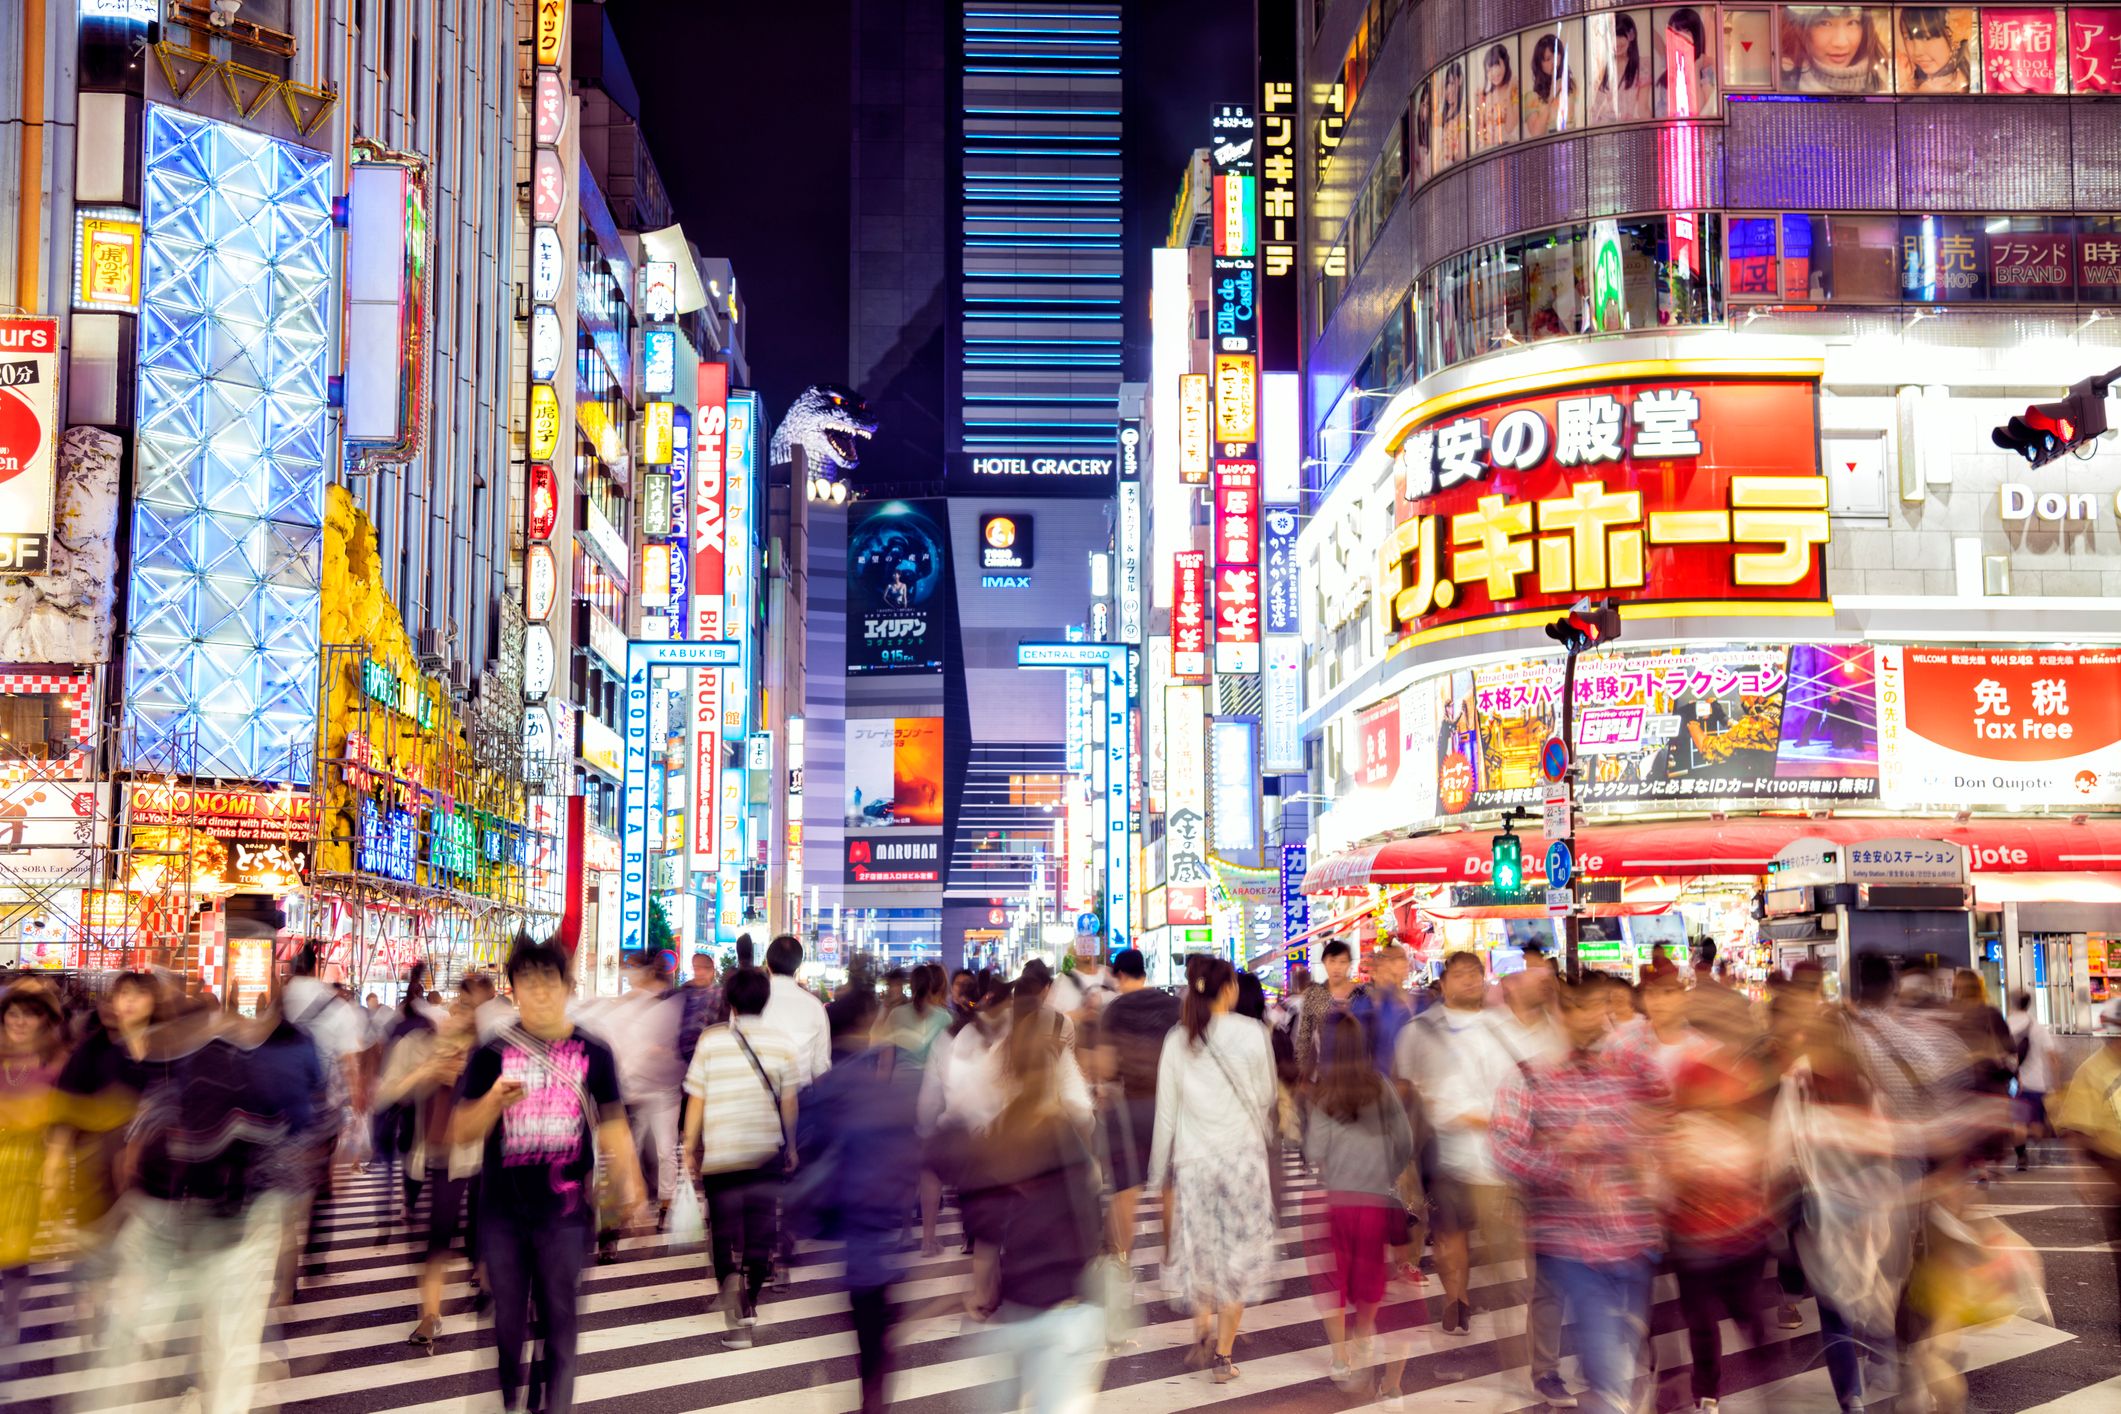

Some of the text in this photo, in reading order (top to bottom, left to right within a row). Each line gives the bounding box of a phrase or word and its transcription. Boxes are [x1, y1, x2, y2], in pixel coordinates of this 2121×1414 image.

[1989, 21, 2052, 52] 新宿
[2016, 59, 2049, 69] IDOL
[2016, 68, 2054, 79] STAGE
[88, 221, 110, 231] 4F
[1993, 242, 2067, 265] ブランド
[99, 247, 122, 285] 虎の子
[1995, 266, 2067, 284] BRAND
[1235, 270, 1253, 321] Castle
[1218, 278, 1235, 335] Elle de
[536, 406, 555, 442] 虎の子
[1224, 442, 1248, 458] 6F
[973, 459, 1113, 475] HOTEL GRACERY
[697, 406, 725, 554] SHIDAX
[1999, 483, 2098, 521] Don
[982, 576, 1030, 588] IMAX
[864, 618, 927, 638] エイリアン
[1023, 650, 1110, 659] CENTRAL ROAD
[1576, 661, 1600, 672] real
[1603, 659, 1624, 672] spy
[1628, 655, 1700, 669] experience
[1912, 654, 1948, 664] WELCOME
[1974, 718, 2074, 740] Tax Free
[1955, 776, 1986, 788] Don
[133, 788, 256, 814] OKONOMI
[625, 690, 645, 922] GODZILLA ROAD
[1111, 711, 1125, 905] ゴジラロード
[208, 815, 239, 827] dinner
[240, 818, 260, 828] with
[206, 826, 236, 838] Drinks
[238, 828, 251, 838] for
[260, 829, 287, 840] hours
[721, 785, 739, 925] カラオケ館
[876, 843, 938, 860] MARUHAN
[1852, 850, 1955, 864] 安全安心ステーション
[22, 865, 47, 873] SOBA
[1464, 851, 1604, 875] Do Qute
